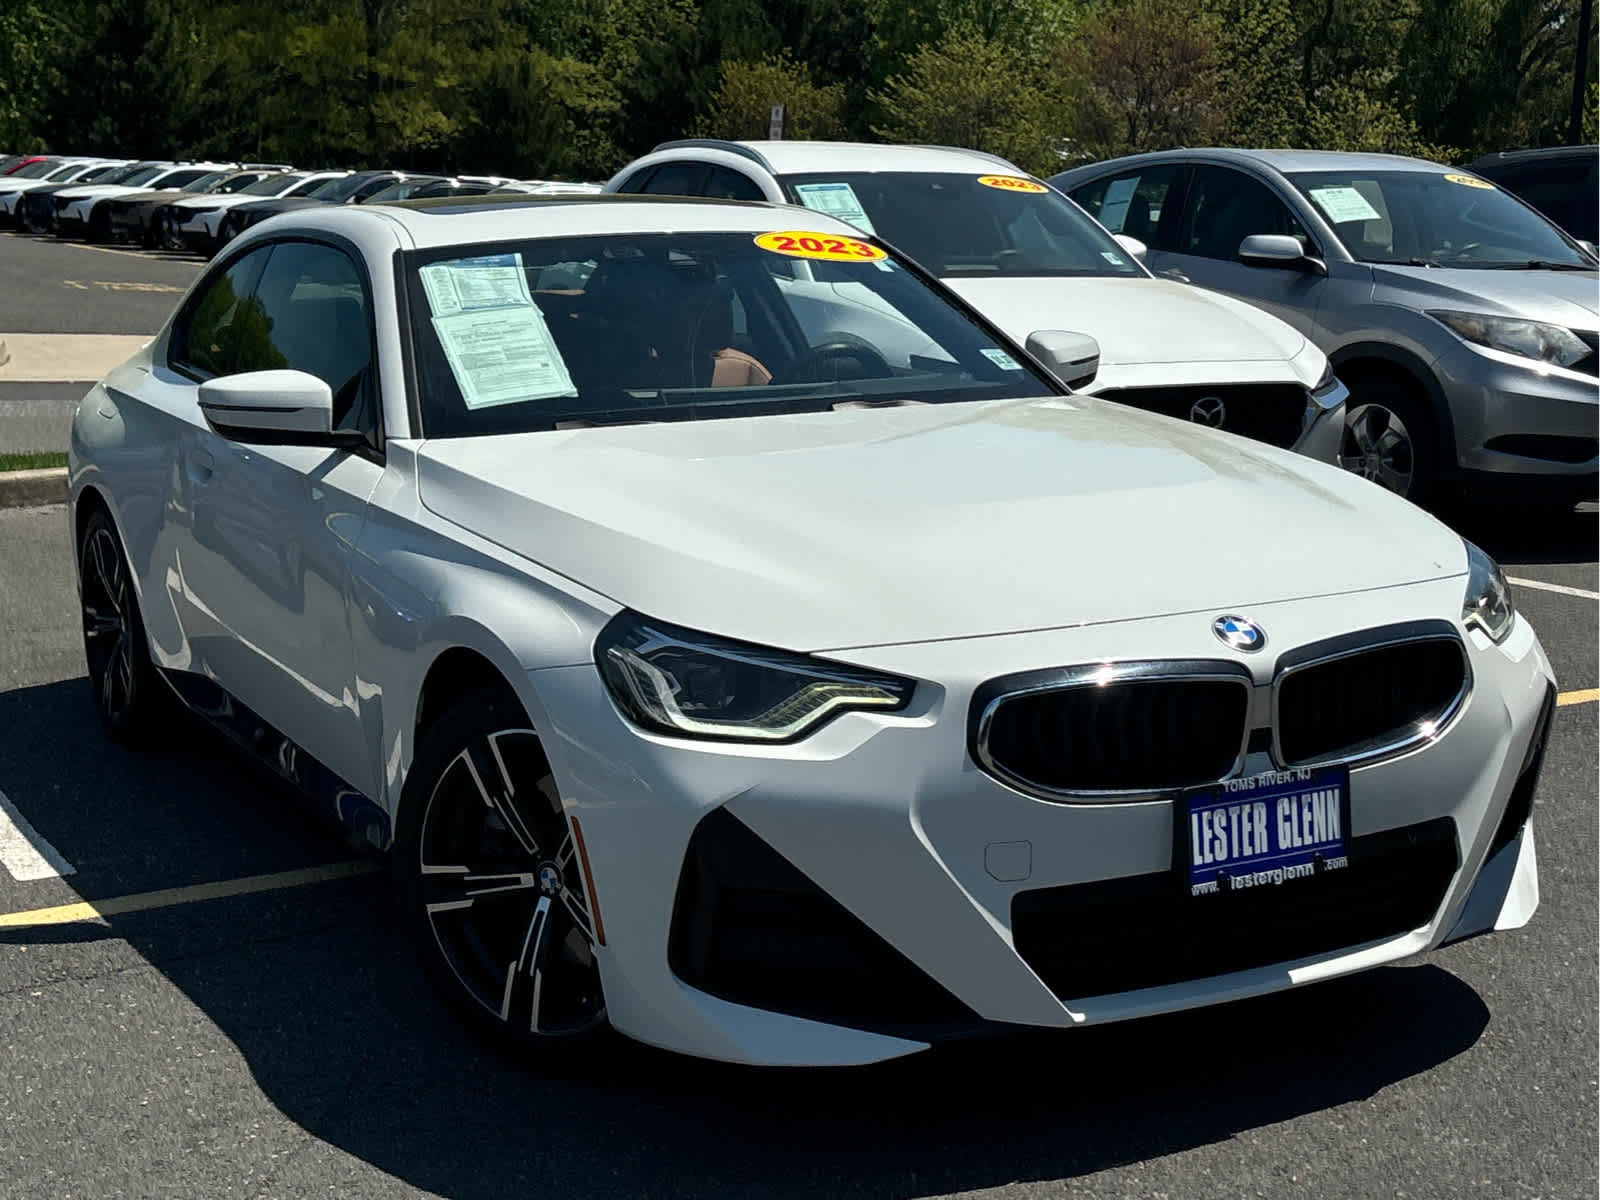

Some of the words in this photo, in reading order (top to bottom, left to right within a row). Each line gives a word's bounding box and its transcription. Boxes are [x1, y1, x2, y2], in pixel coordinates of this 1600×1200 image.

[772, 236, 875, 258] 2023
[1223, 779, 1256, 793] TOMS
[1297, 769, 1311, 781] NJ
[1191, 802, 1269, 866] LESTER
[1277, 789, 1341, 850] GLENN
